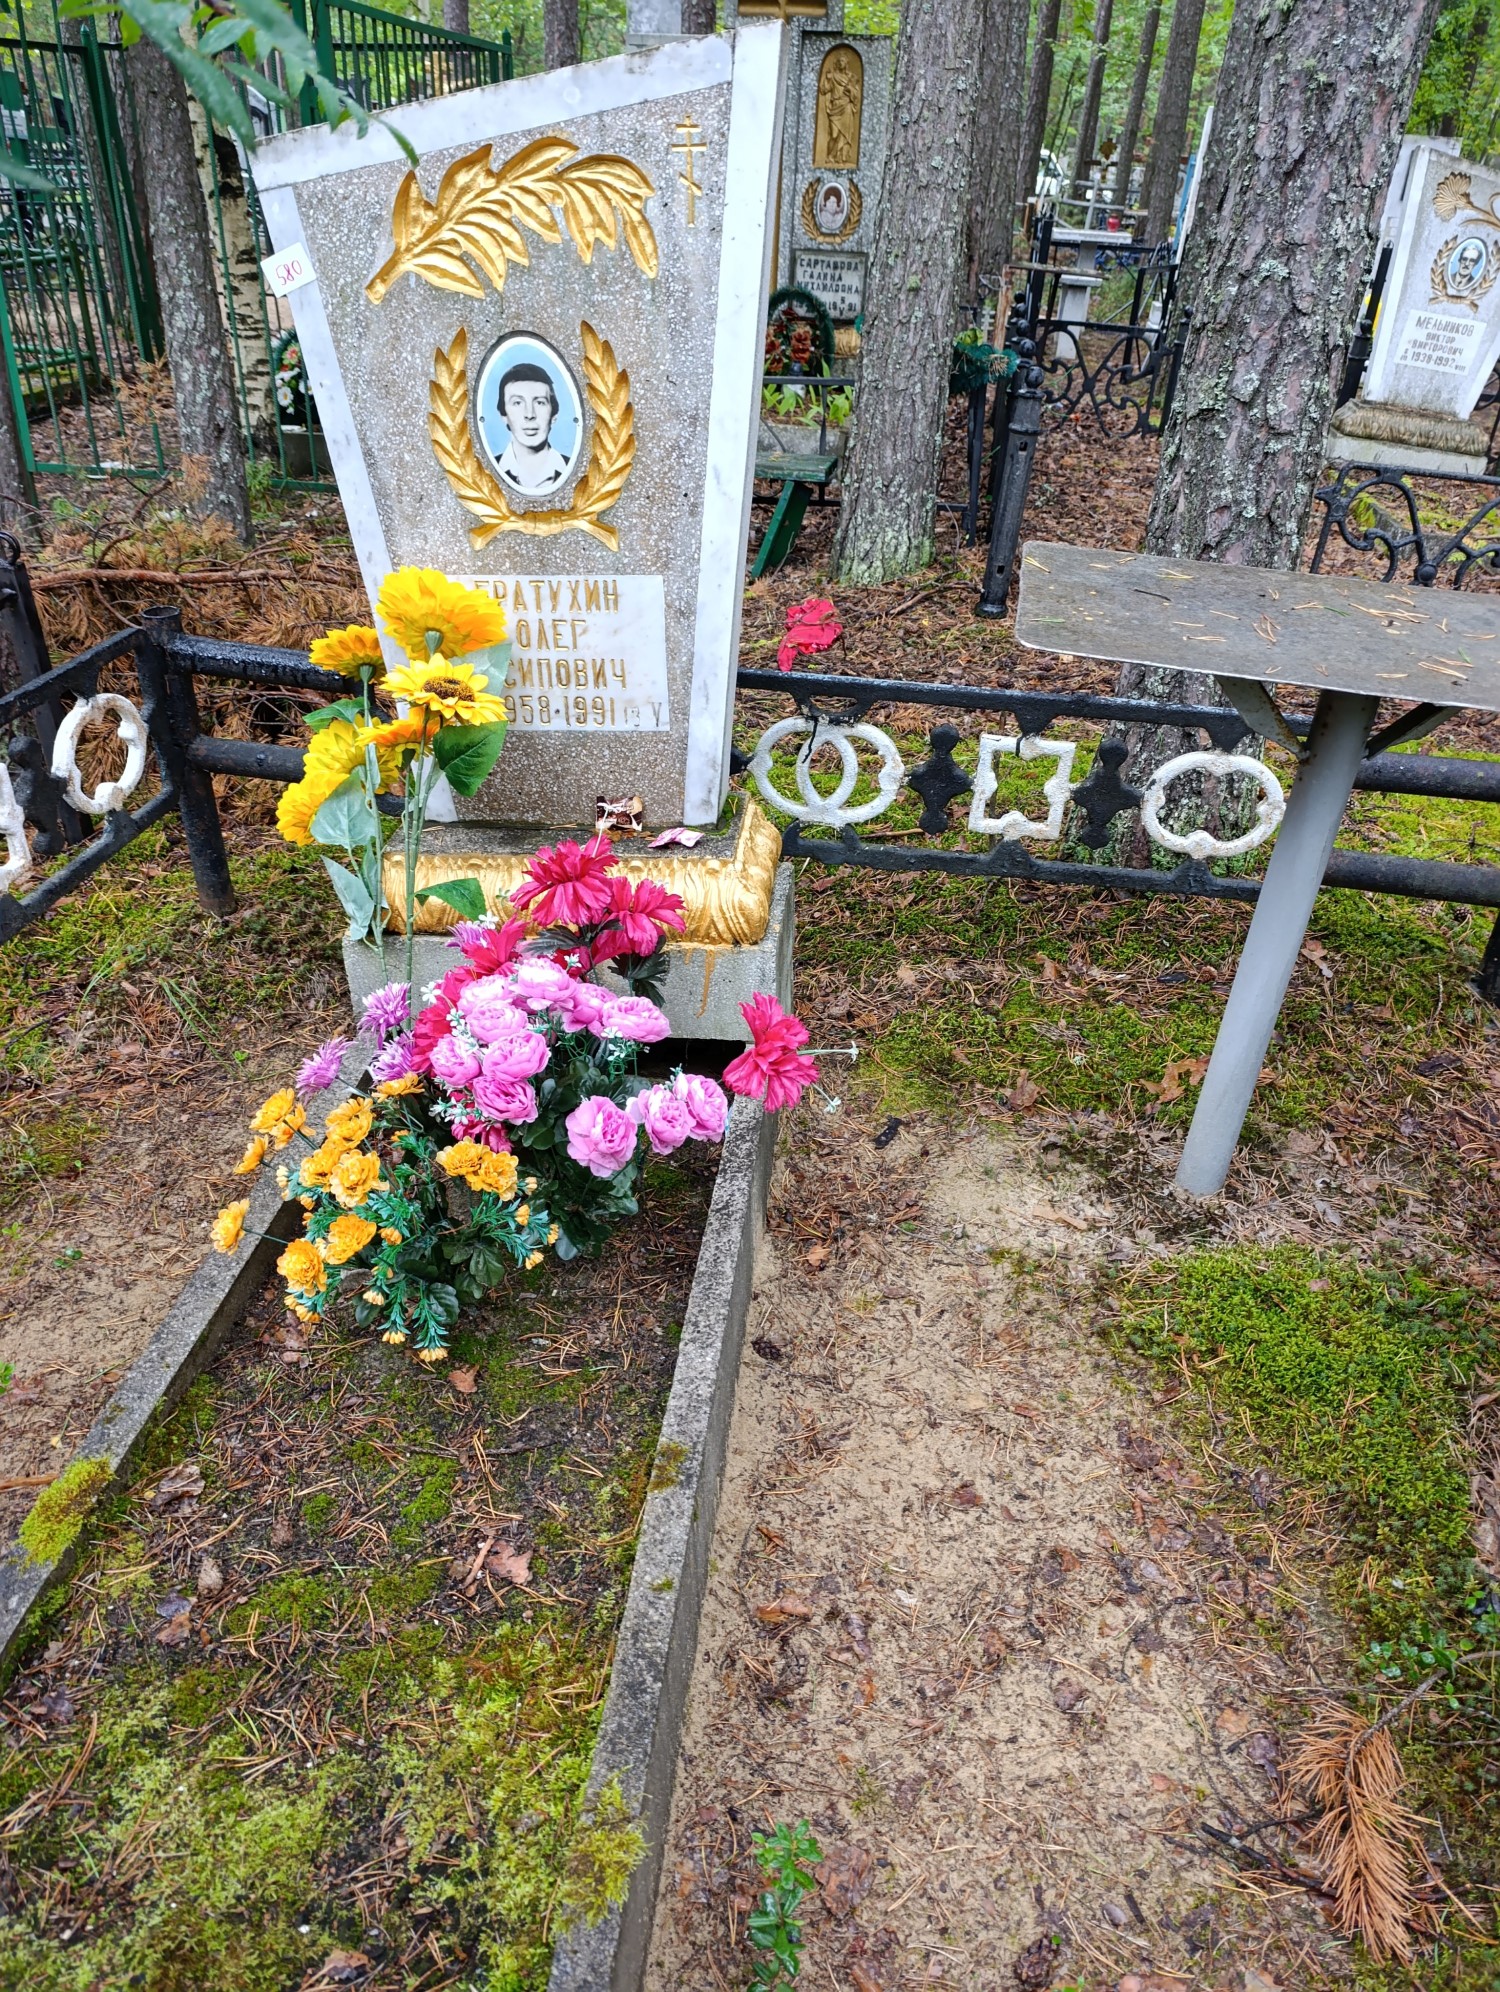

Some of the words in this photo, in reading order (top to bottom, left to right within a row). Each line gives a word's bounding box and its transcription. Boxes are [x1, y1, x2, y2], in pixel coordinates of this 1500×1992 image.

[275, 259, 303, 286] 580
[802, 270, 843, 282] ГАЛИНА
[1415, 315, 1475, 337] МЕЛЬНИКОВ
[1425, 332, 1456, 344] ВИКТОР
[474, 579, 620, 613] РАТУХИН
[515, 618, 587, 651] ОЛЕГ
[504, 658, 627, 690] СИПОВИЧ
